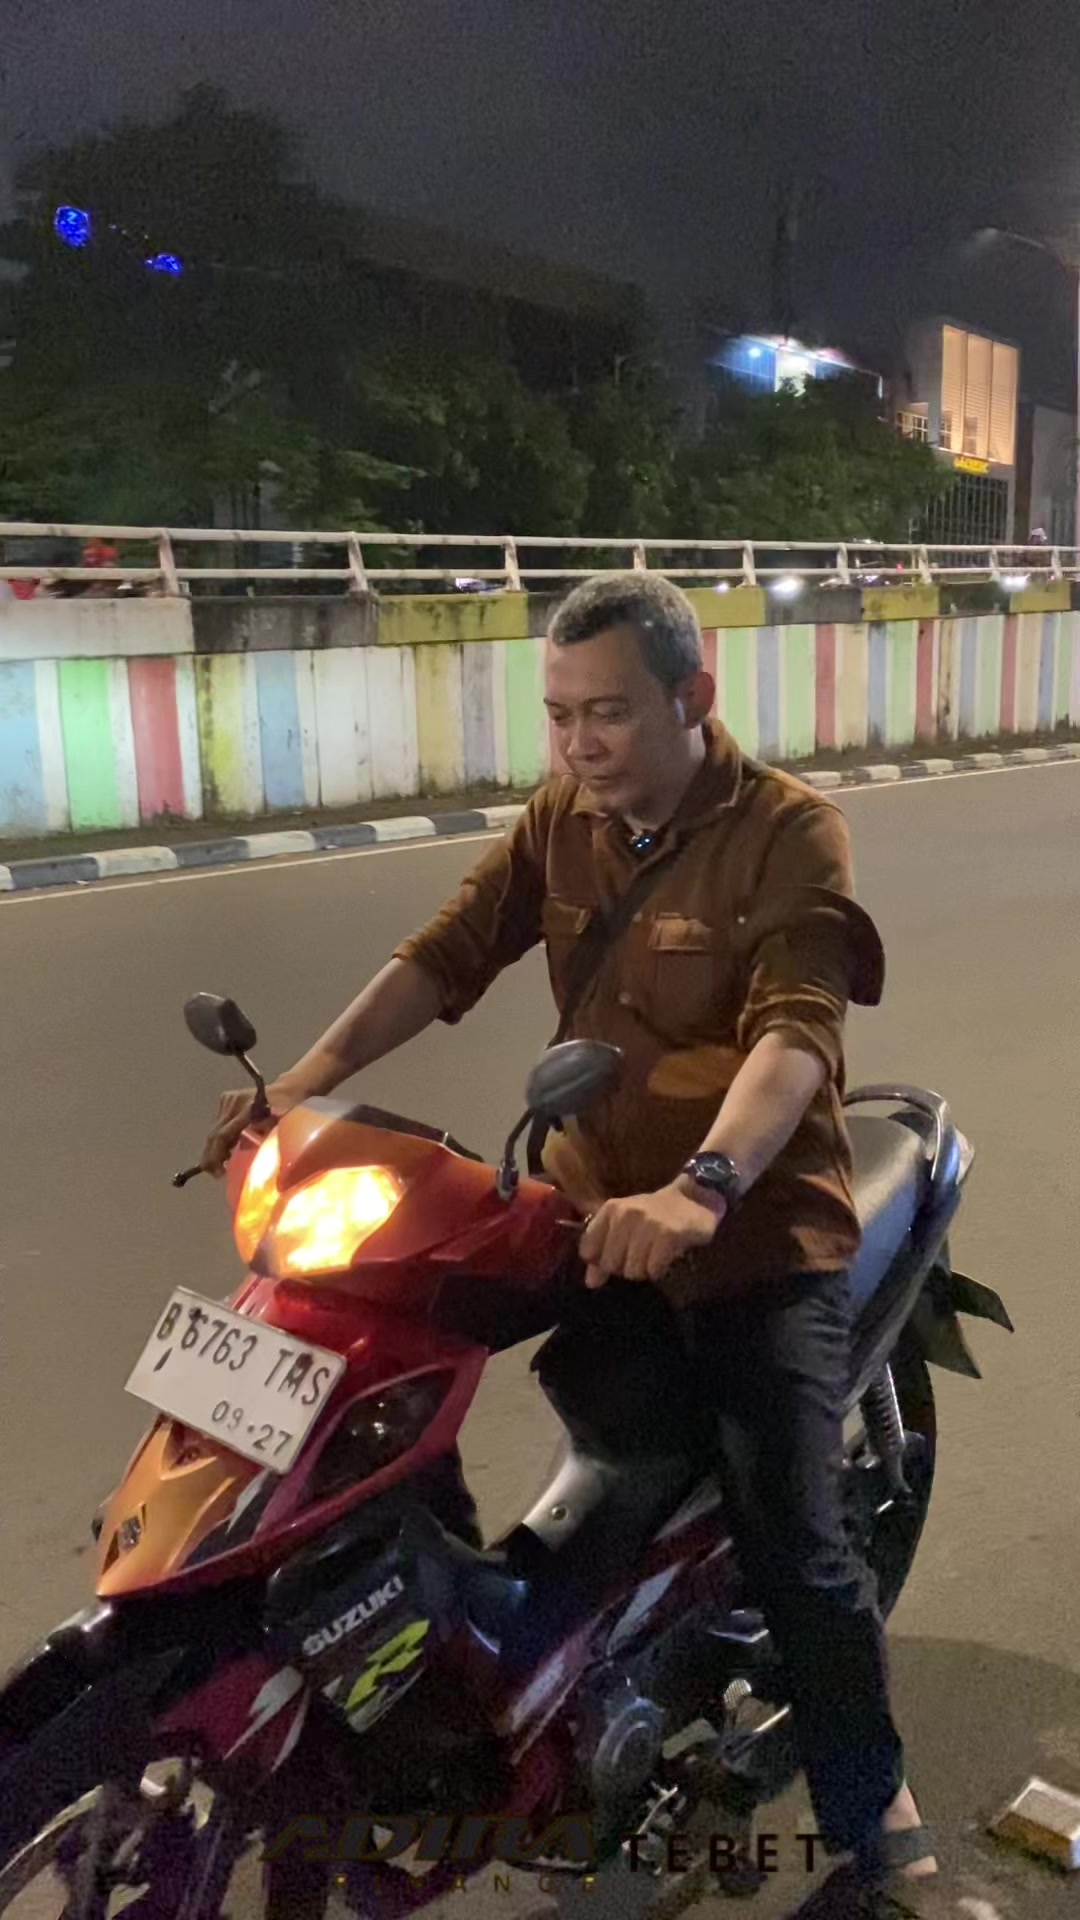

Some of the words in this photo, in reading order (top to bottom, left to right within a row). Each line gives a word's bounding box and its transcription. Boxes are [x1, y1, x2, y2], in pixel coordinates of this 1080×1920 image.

[157, 1302, 182, 1341] B
[181, 1310, 258, 1371] 6763
[302, 1574, 405, 1657] SUZUKI
